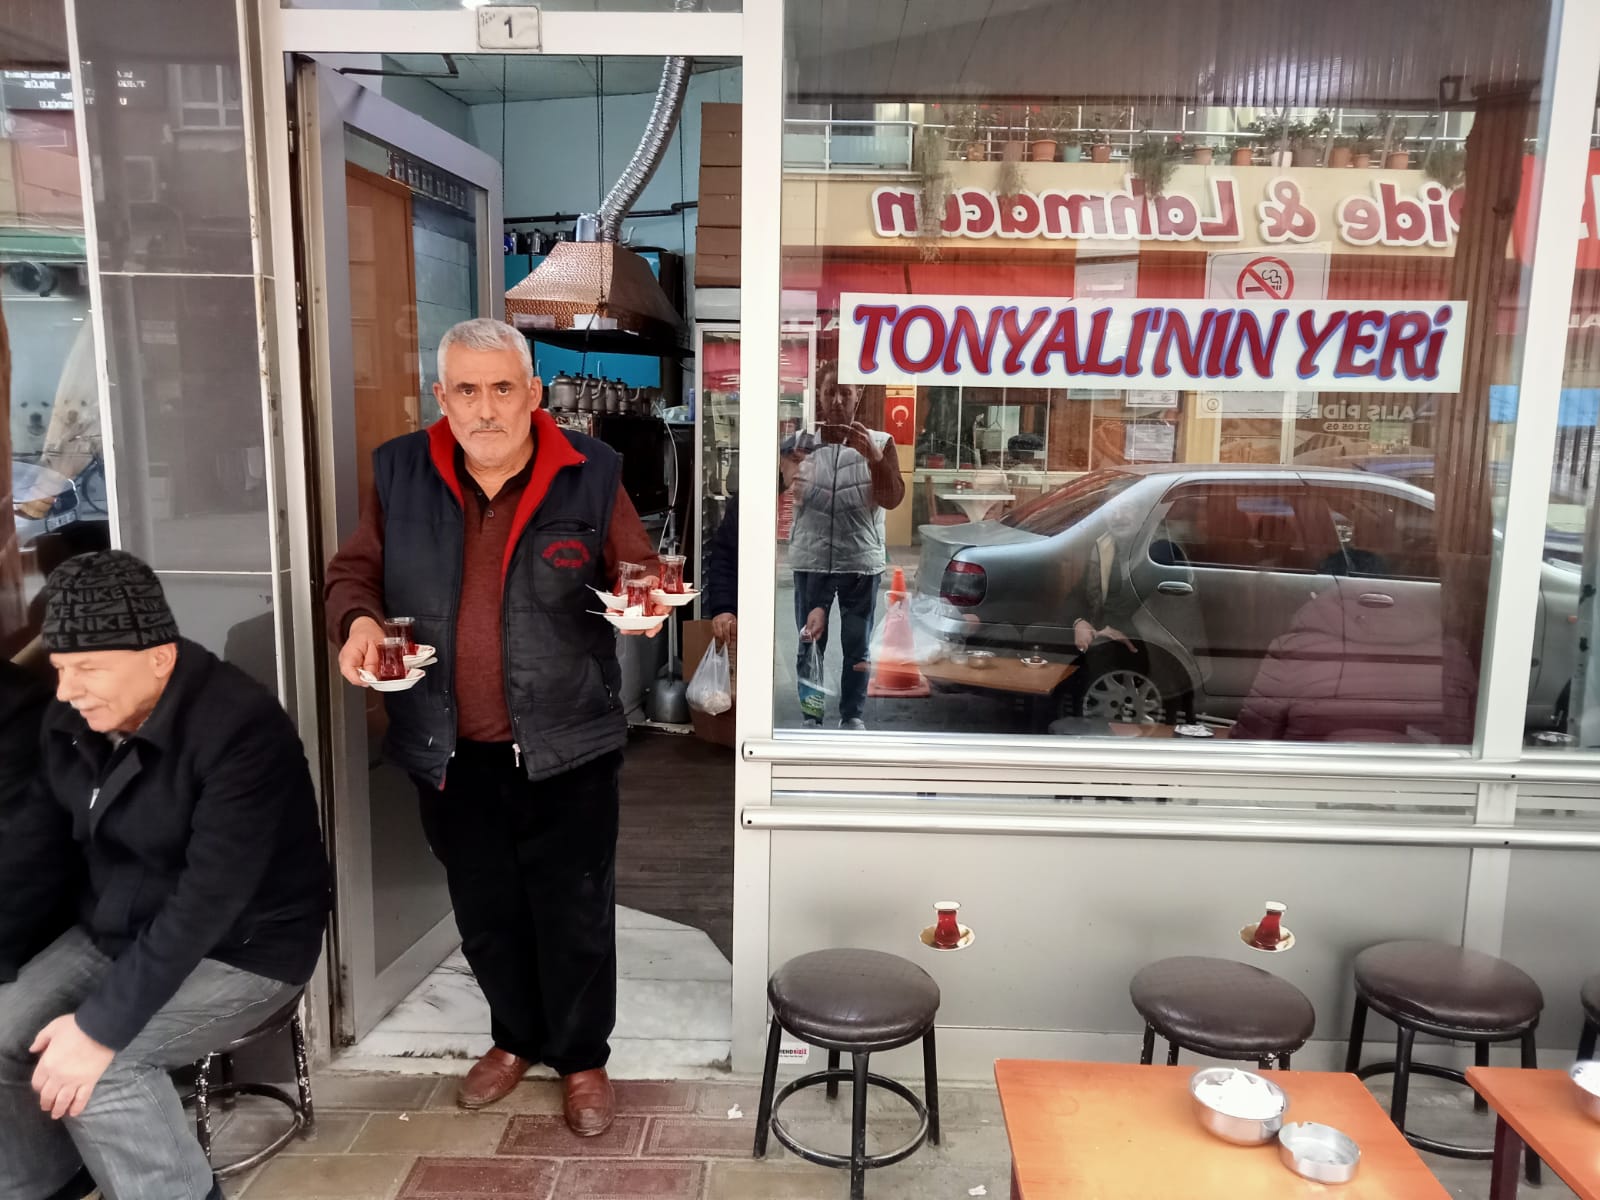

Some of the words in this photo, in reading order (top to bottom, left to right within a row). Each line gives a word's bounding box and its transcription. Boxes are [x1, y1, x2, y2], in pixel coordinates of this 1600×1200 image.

[503, 15, 513, 39] 1
[66, 584, 125, 604] NIKE
[64, 613, 133, 632] NIKE
